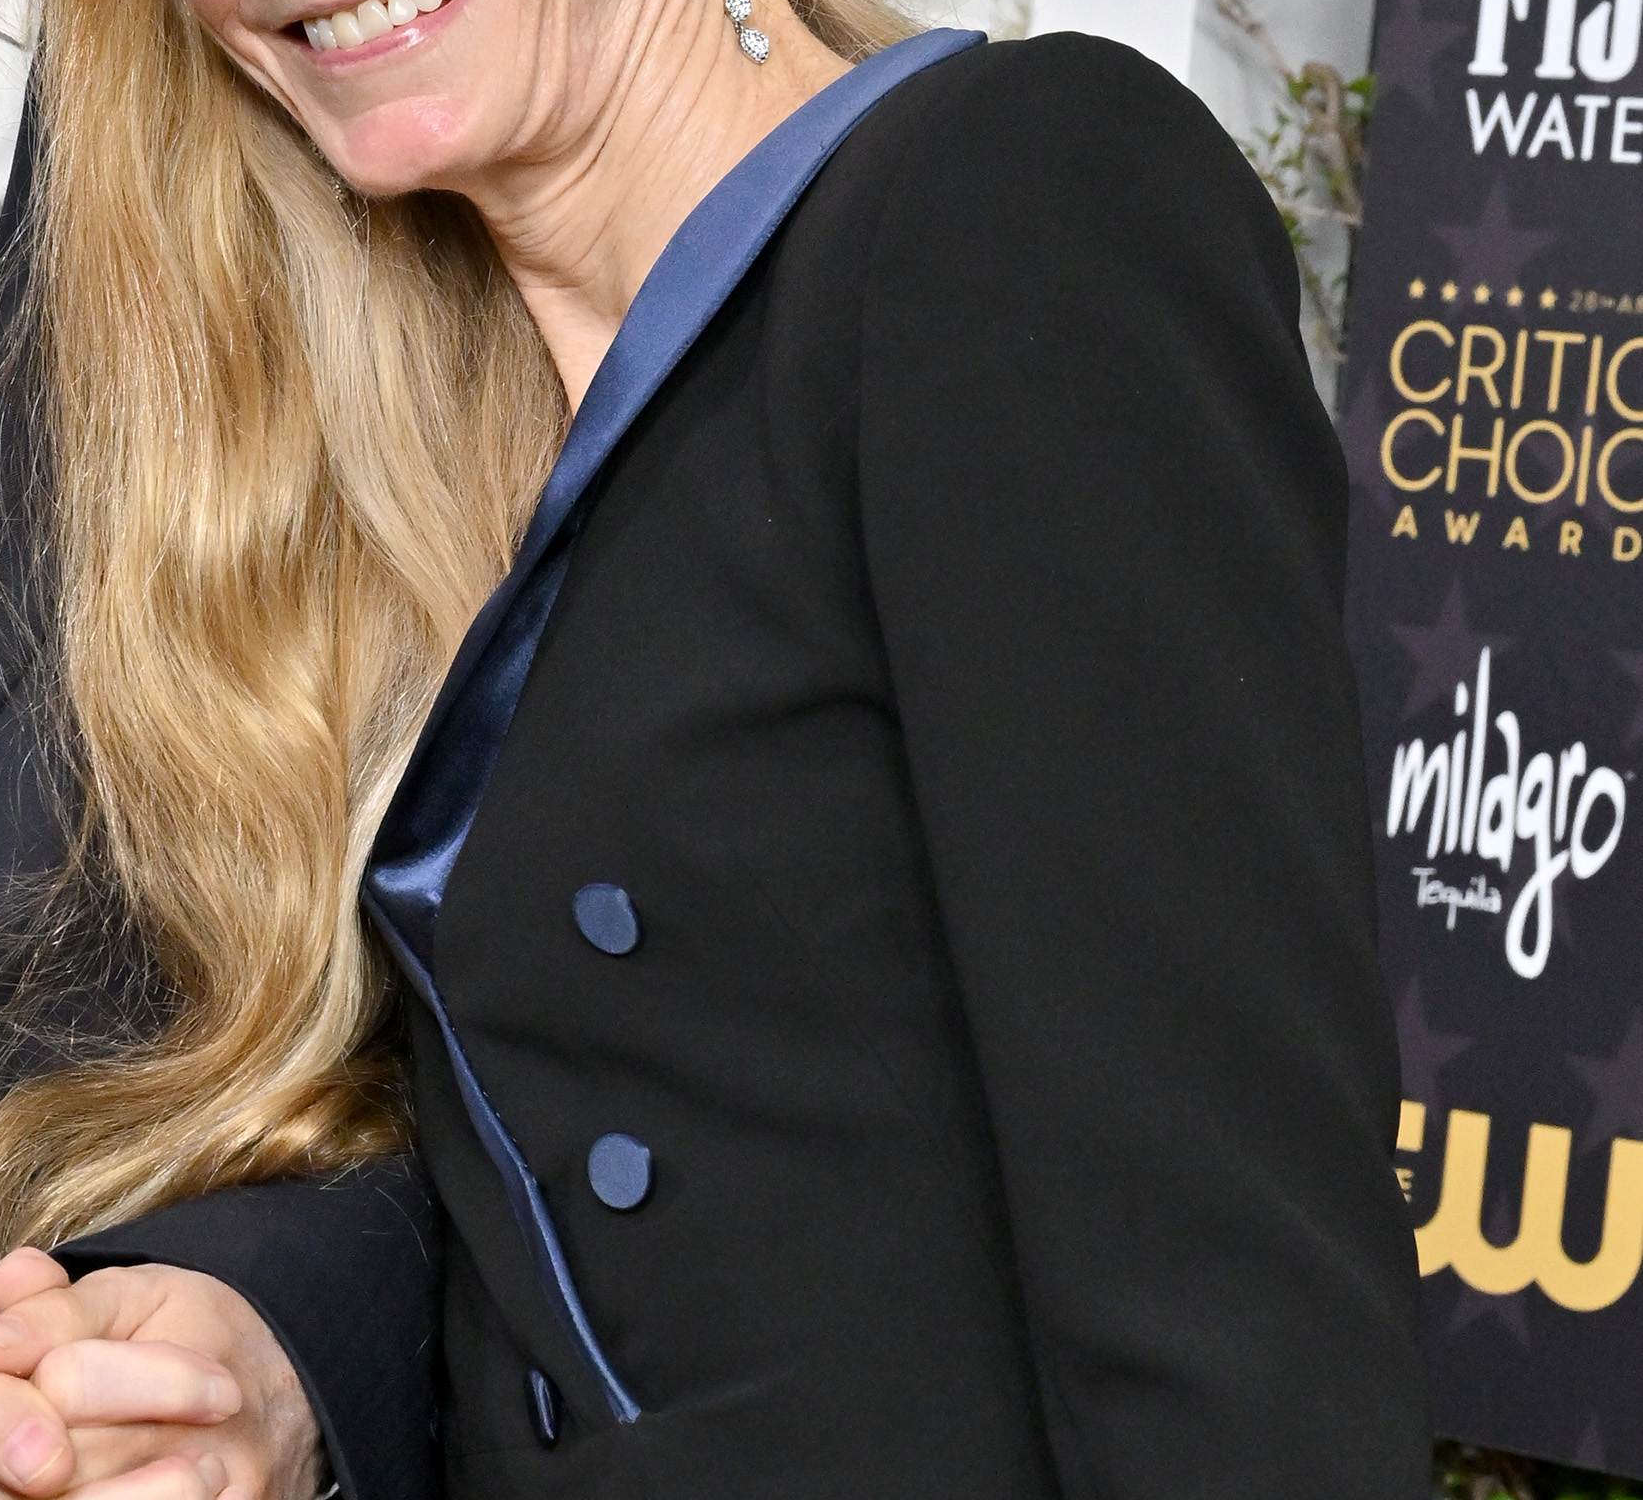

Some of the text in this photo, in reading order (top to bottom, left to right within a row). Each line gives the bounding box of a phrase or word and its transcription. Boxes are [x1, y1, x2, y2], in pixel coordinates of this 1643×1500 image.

[1465, 88, 1643, 164] WATE
[1381, 408, 1643, 513] CHOIC
[1391, 505, 1643, 562] AWARD
[1411, 867, 1503, 931] Tequila
